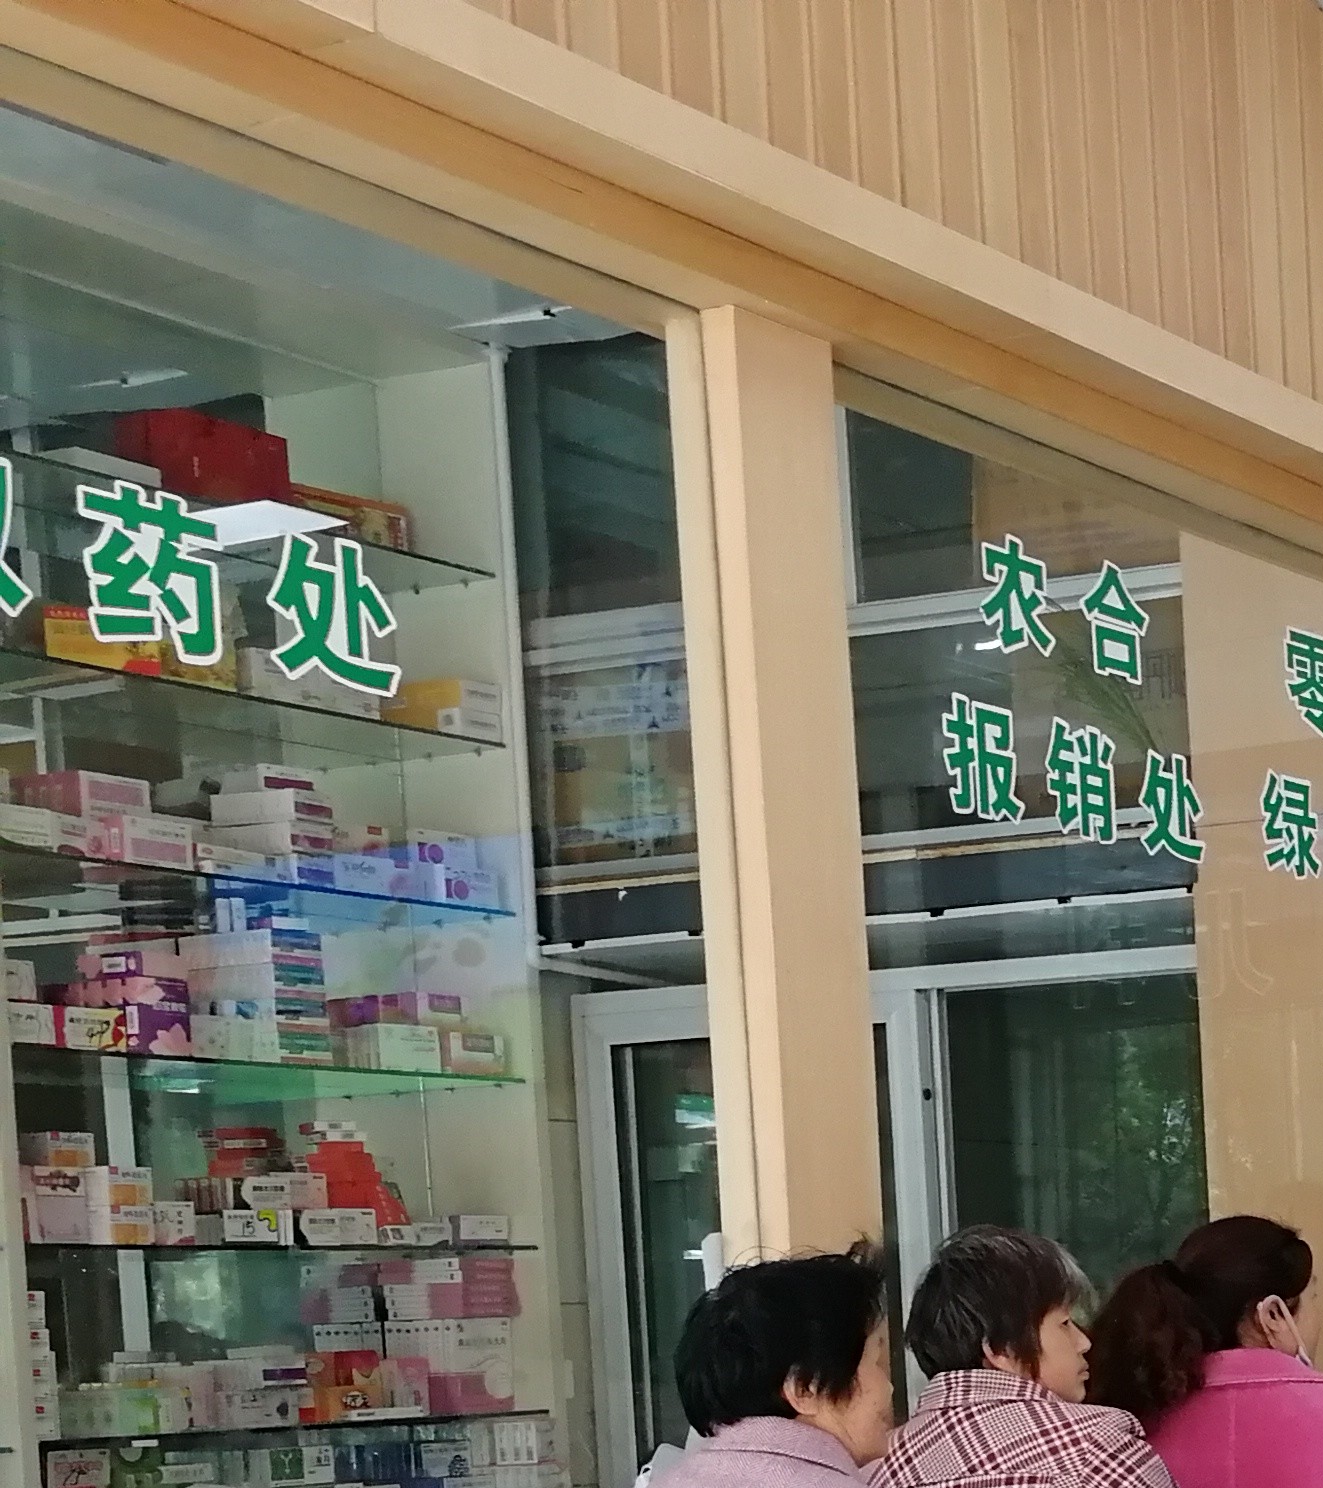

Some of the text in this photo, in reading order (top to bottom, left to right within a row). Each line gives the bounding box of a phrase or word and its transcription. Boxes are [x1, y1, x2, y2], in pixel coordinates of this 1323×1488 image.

[981, 534, 1149, 684] 农合
[942, 693, 1205, 864] 报销处
